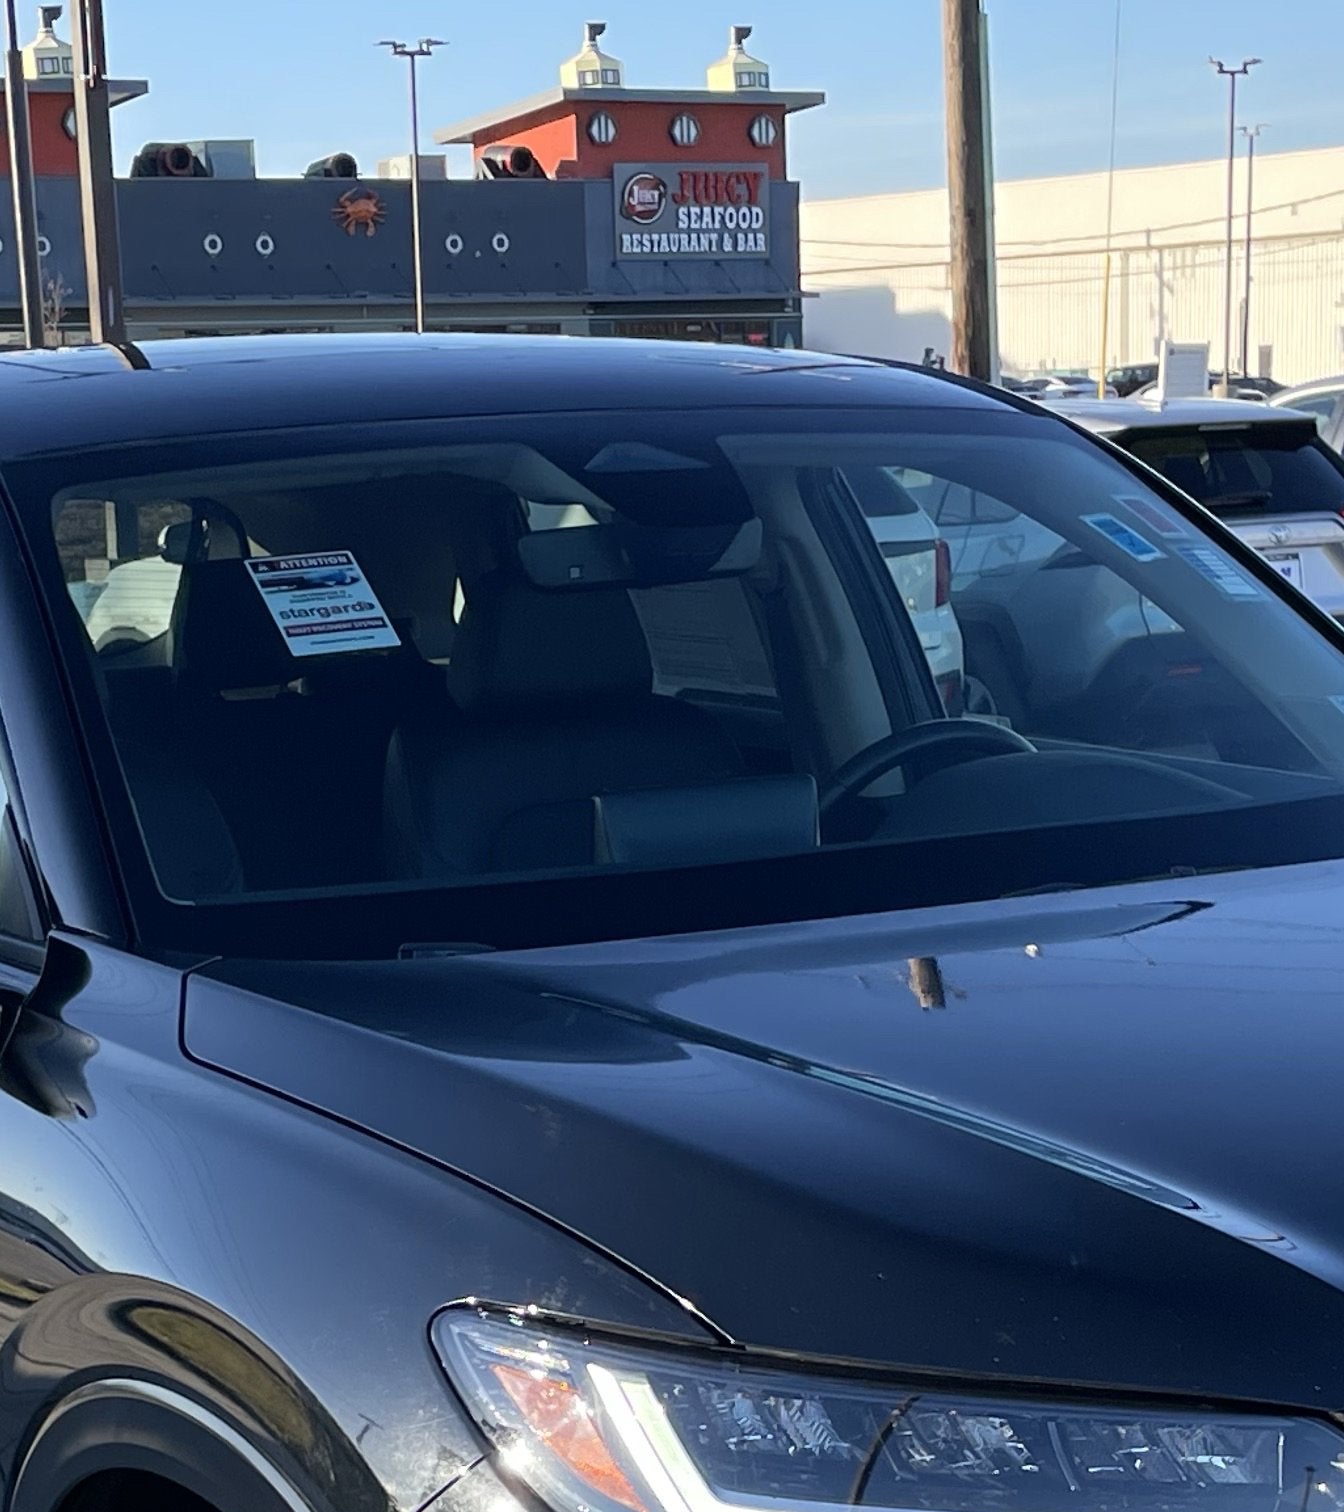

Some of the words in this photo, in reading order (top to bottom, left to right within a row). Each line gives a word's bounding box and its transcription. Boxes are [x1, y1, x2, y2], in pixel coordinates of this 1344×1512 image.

[672, 171, 763, 204] JUICY
[678, 206, 764, 229] SEAFOOD
[621, 233, 719, 253] RESTAURANT
[723, 232, 733, 252] &
[737, 232, 766, 252] BAR
[279, 555, 348, 570] ATTENTION
